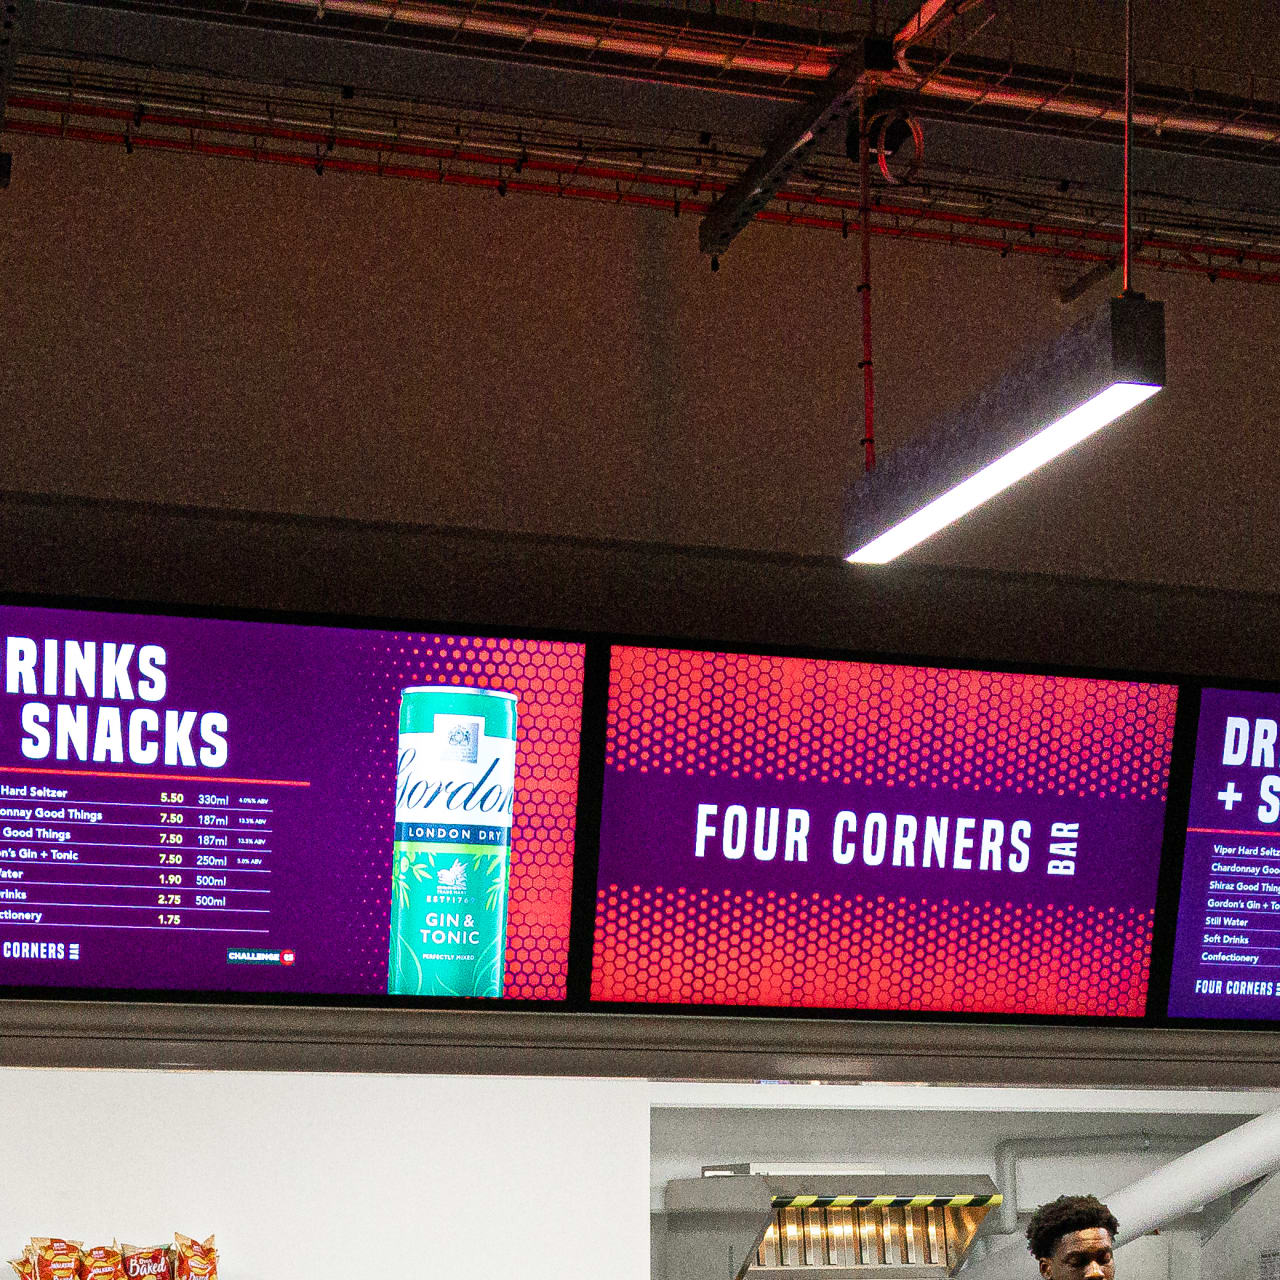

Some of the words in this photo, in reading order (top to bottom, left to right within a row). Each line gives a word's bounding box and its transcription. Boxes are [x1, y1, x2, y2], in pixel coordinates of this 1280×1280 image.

[21, 702, 227, 768] SNACKS
[0, 785, 27, 797] Hard
[30, 786, 67, 798] Seltzer
[160, 792, 184, 803] 5.50
[198, 794, 228, 805] 330ml
[1217, 782, 1243, 810] +
[35, 807, 64, 818] Good
[68, 809, 102, 822] Things
[160, 813, 183, 824] 7.50
[198, 815, 228, 826] 187ml
[3, 828, 33, 838] Good
[36, 829, 71, 841] Things
[160, 834, 183, 844] 7.50
[198, 835, 227, 846] 187ml
[408, 827, 471, 840] LONDON
[479, 829, 502, 841] DRY
[695, 803, 811, 862] FOUR
[832, 810, 1032, 874] CORNERS
[1047, 821, 1080, 876] BAR
[19, 848, 37, 859] Gin
[40, 851, 48, 859] +
[50, 850, 78, 861] Tonic
[159, 854, 182, 865] 7.50
[197, 855, 227, 866] 250ml
[1214, 845, 1236, 856] Viper
[1238, 846, 1258, 855] Hard
[1212, 863, 1260, 875] Chardonnay
[159, 875, 181, 885] 1.90
[196, 875, 226, 886] 500ml
[1210, 881, 1234, 890] Shiraz
[1236, 882, 1259, 891] Good
[158, 895, 181, 905] 2.75
[196, 895, 225, 906] 500ml
[1246, 900, 1260, 909] Gin
[158, 915, 180, 925] 1.75
[425, 912, 460, 927] GIN
[463, 915, 474, 928] &
[1206, 916, 1221, 925] Still
[1223, 917, 1248, 927] Water
[420, 929, 480, 945] TONIC
[1204, 934, 1220, 944] Soft
[1223, 935, 1249, 945] Drinks
[3, 942, 64, 959] CORNERS
[228, 952, 279, 961] CHALLENGE
[1201, 952, 1259, 964] Confectionery
[1195, 980, 1222, 994] FOUR
[1226, 980, 1272, 995] CORNERS
[129, 1258, 166, 1276] Baked
